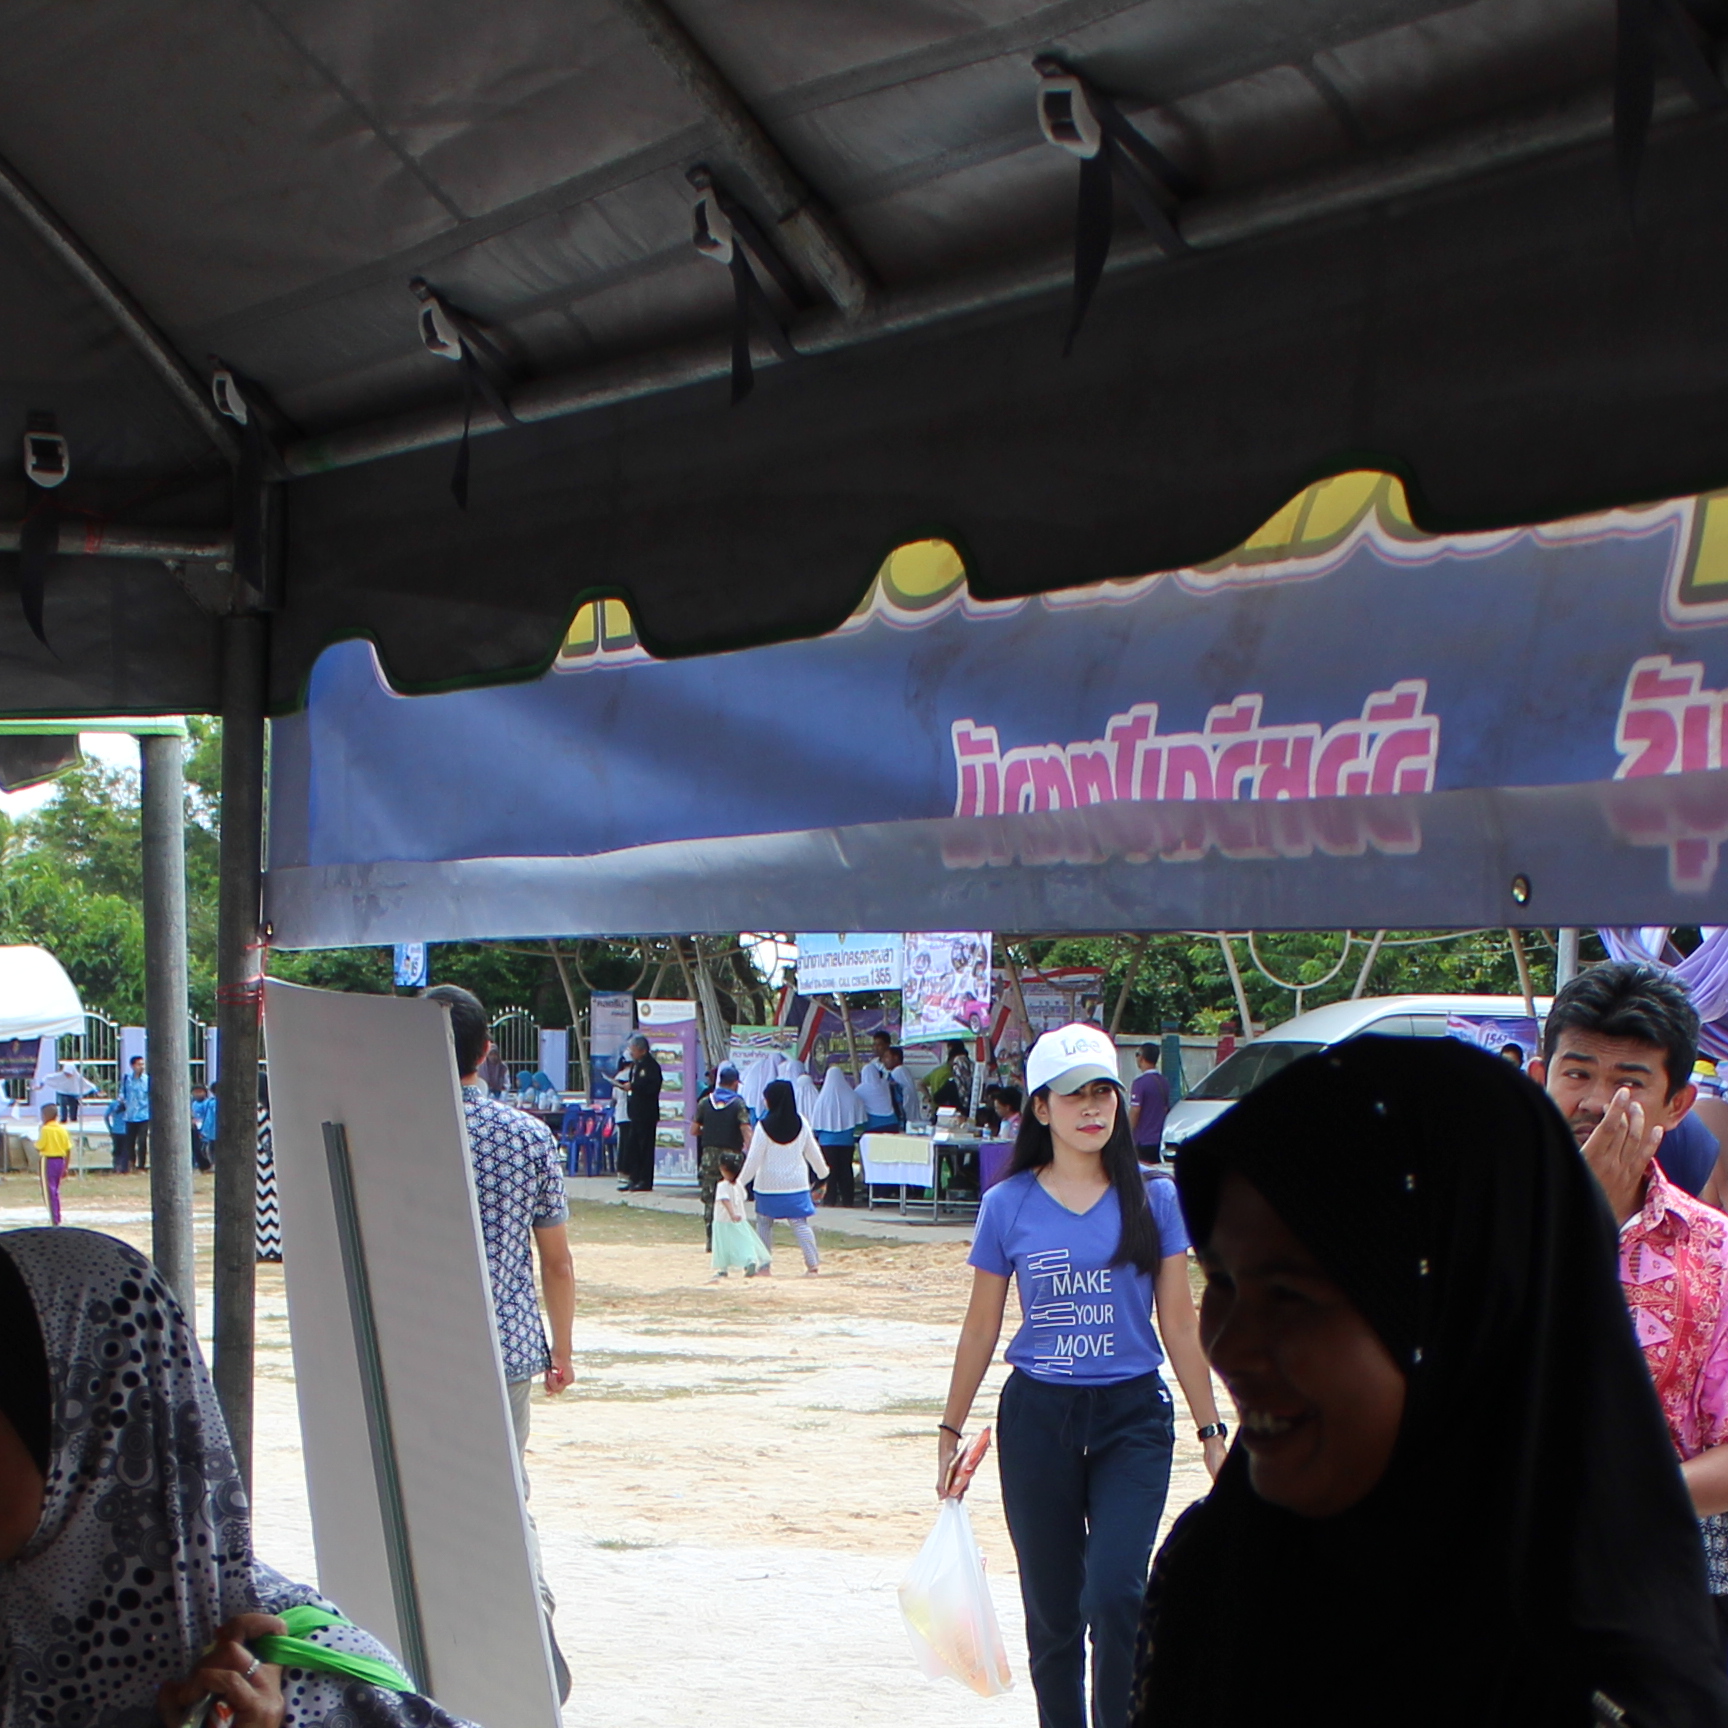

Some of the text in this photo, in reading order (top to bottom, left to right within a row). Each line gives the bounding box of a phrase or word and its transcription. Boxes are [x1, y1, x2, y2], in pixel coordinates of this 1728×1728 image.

[870, 967, 891, 986] 1355
[1061, 1038, 1102, 1057] Lee
[1052, 1269, 1112, 1297] MAKE
[1075, 1304, 1114, 1325] YOUR
[1054, 1333, 1115, 1357] MOVE
